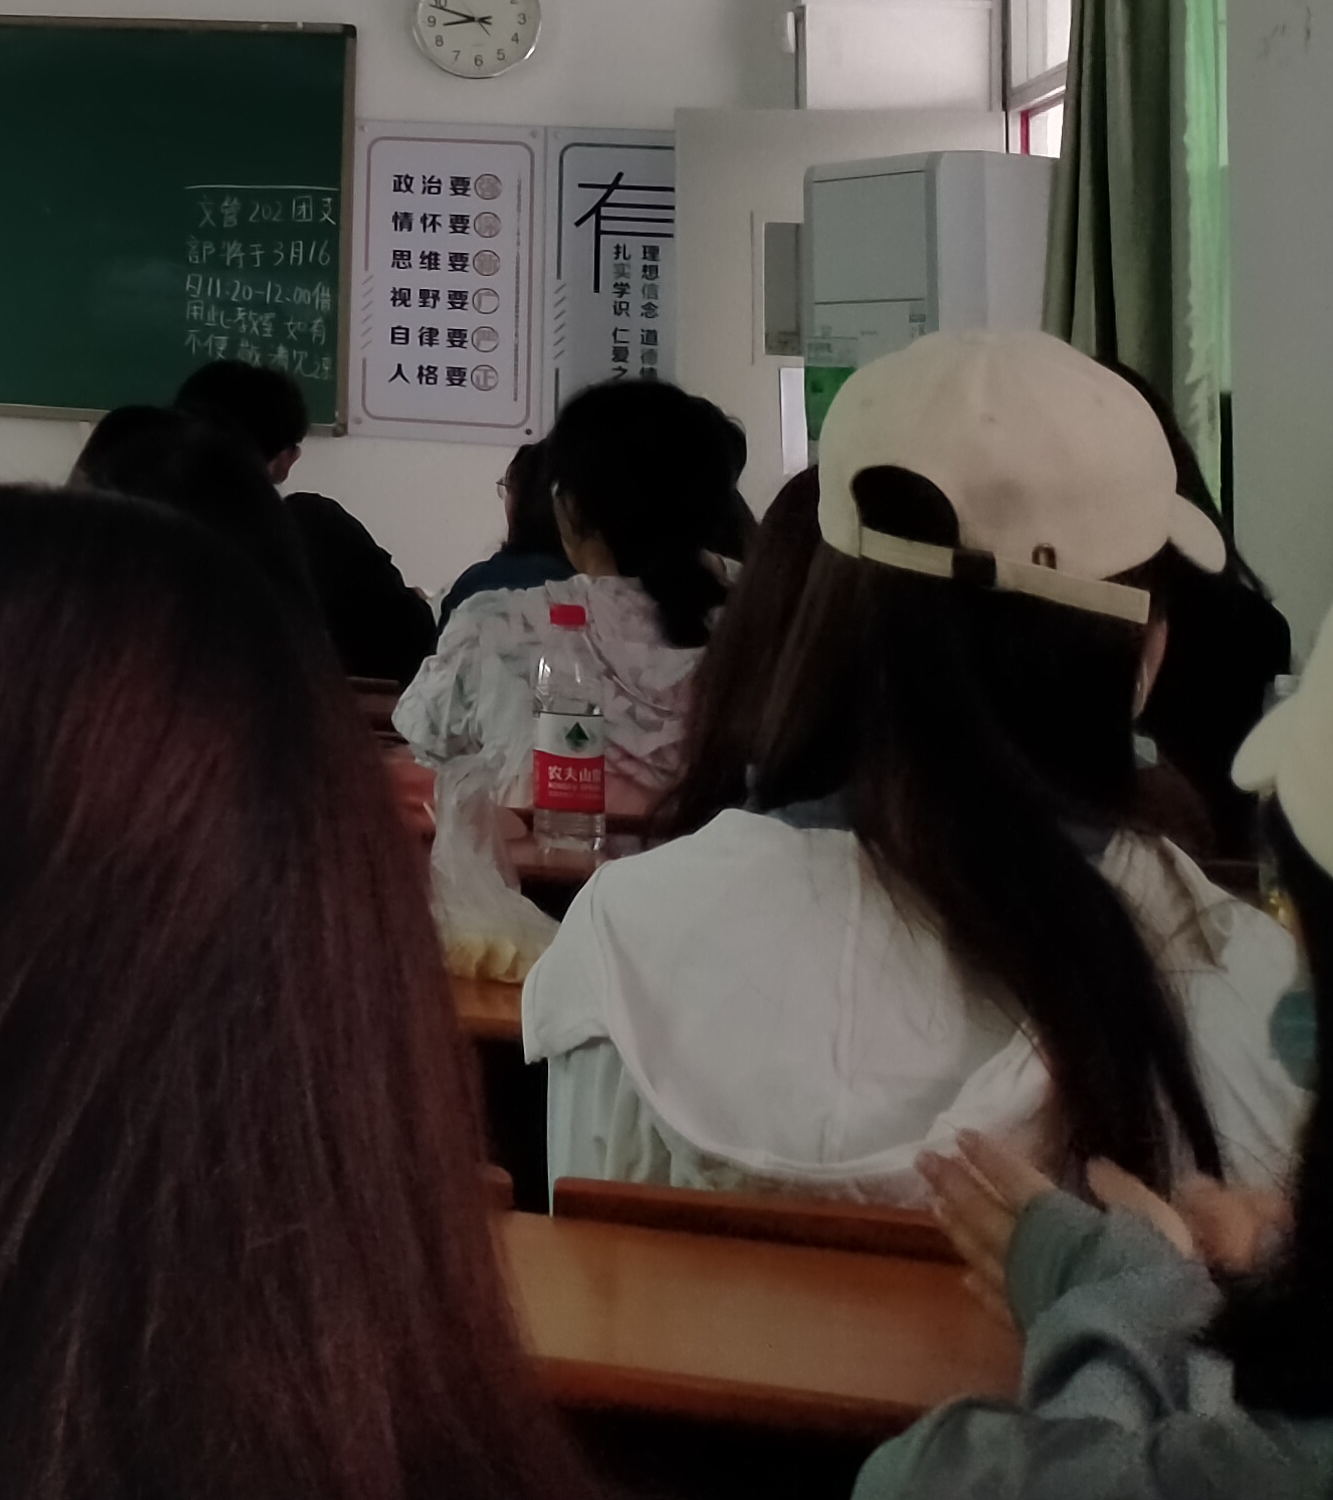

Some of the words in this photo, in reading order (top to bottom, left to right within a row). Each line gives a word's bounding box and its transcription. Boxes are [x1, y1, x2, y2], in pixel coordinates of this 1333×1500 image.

[427, 16, 437, 28] 9
[518, 13, 527, 25] 3
[435, 35, 444, 47] 8
[511, 33, 519, 44] 4
[453, 50, 460, 62] 7
[474, 55, 483, 67] 6
[497, 49, 505, 61] 5
[390, 287, 499, 314] 视野要广
[388, 363, 498, 391] 人格要正
